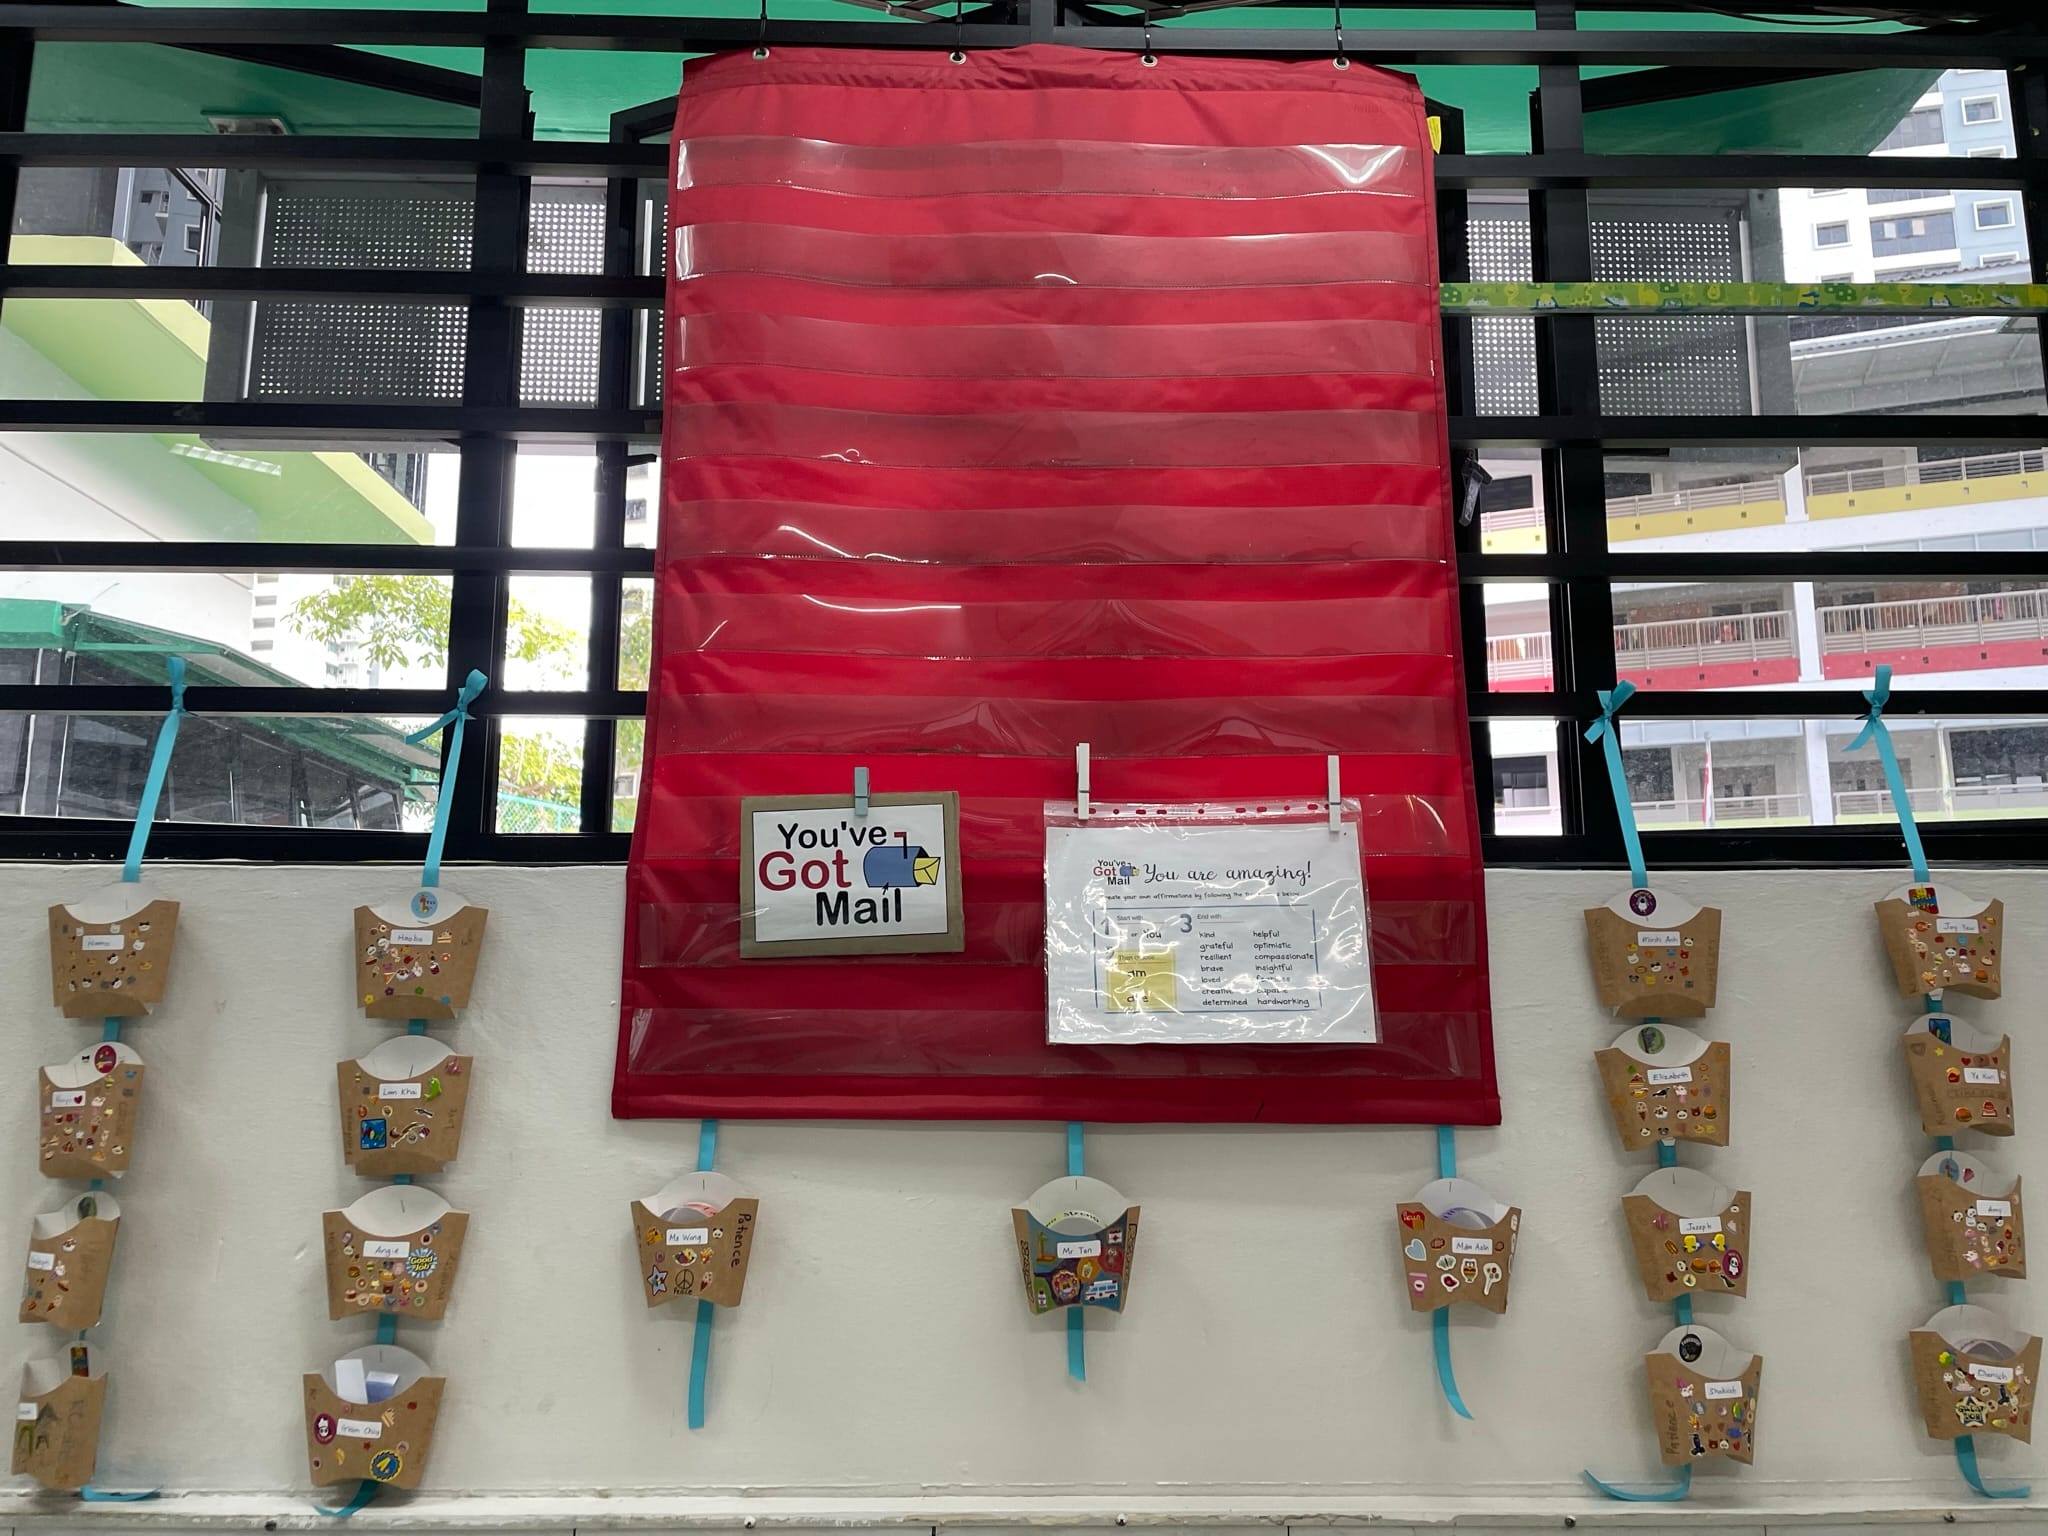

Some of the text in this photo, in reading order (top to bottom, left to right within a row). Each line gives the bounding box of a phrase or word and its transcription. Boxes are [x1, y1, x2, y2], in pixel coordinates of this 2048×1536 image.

[777, 821, 887, 850] You've
[1097, 859, 1126, 867] You've
[758, 849, 852, 891] Got
[1093, 866, 1116, 877] Got
[1143, 860, 1311, 887] You are amazing!
[1107, 876, 1130, 885] Mail
[816, 885, 901, 927] Mail
[1180, 913, 1193, 933] 3
[1253, 930, 1280, 940] helpful
[1199, 942, 1234, 952] grateful
[1253, 943, 1292, 951] optimistic
[1254, 953, 1314, 961] compassionate
[1255, 964, 1293, 974] insightful
[1126, 995, 1149, 1003] ae
[1202, 998, 1248, 1006] determined
[1257, 998, 1310, 1008] hardworking
[731, 1213, 752, 1269] Patience
